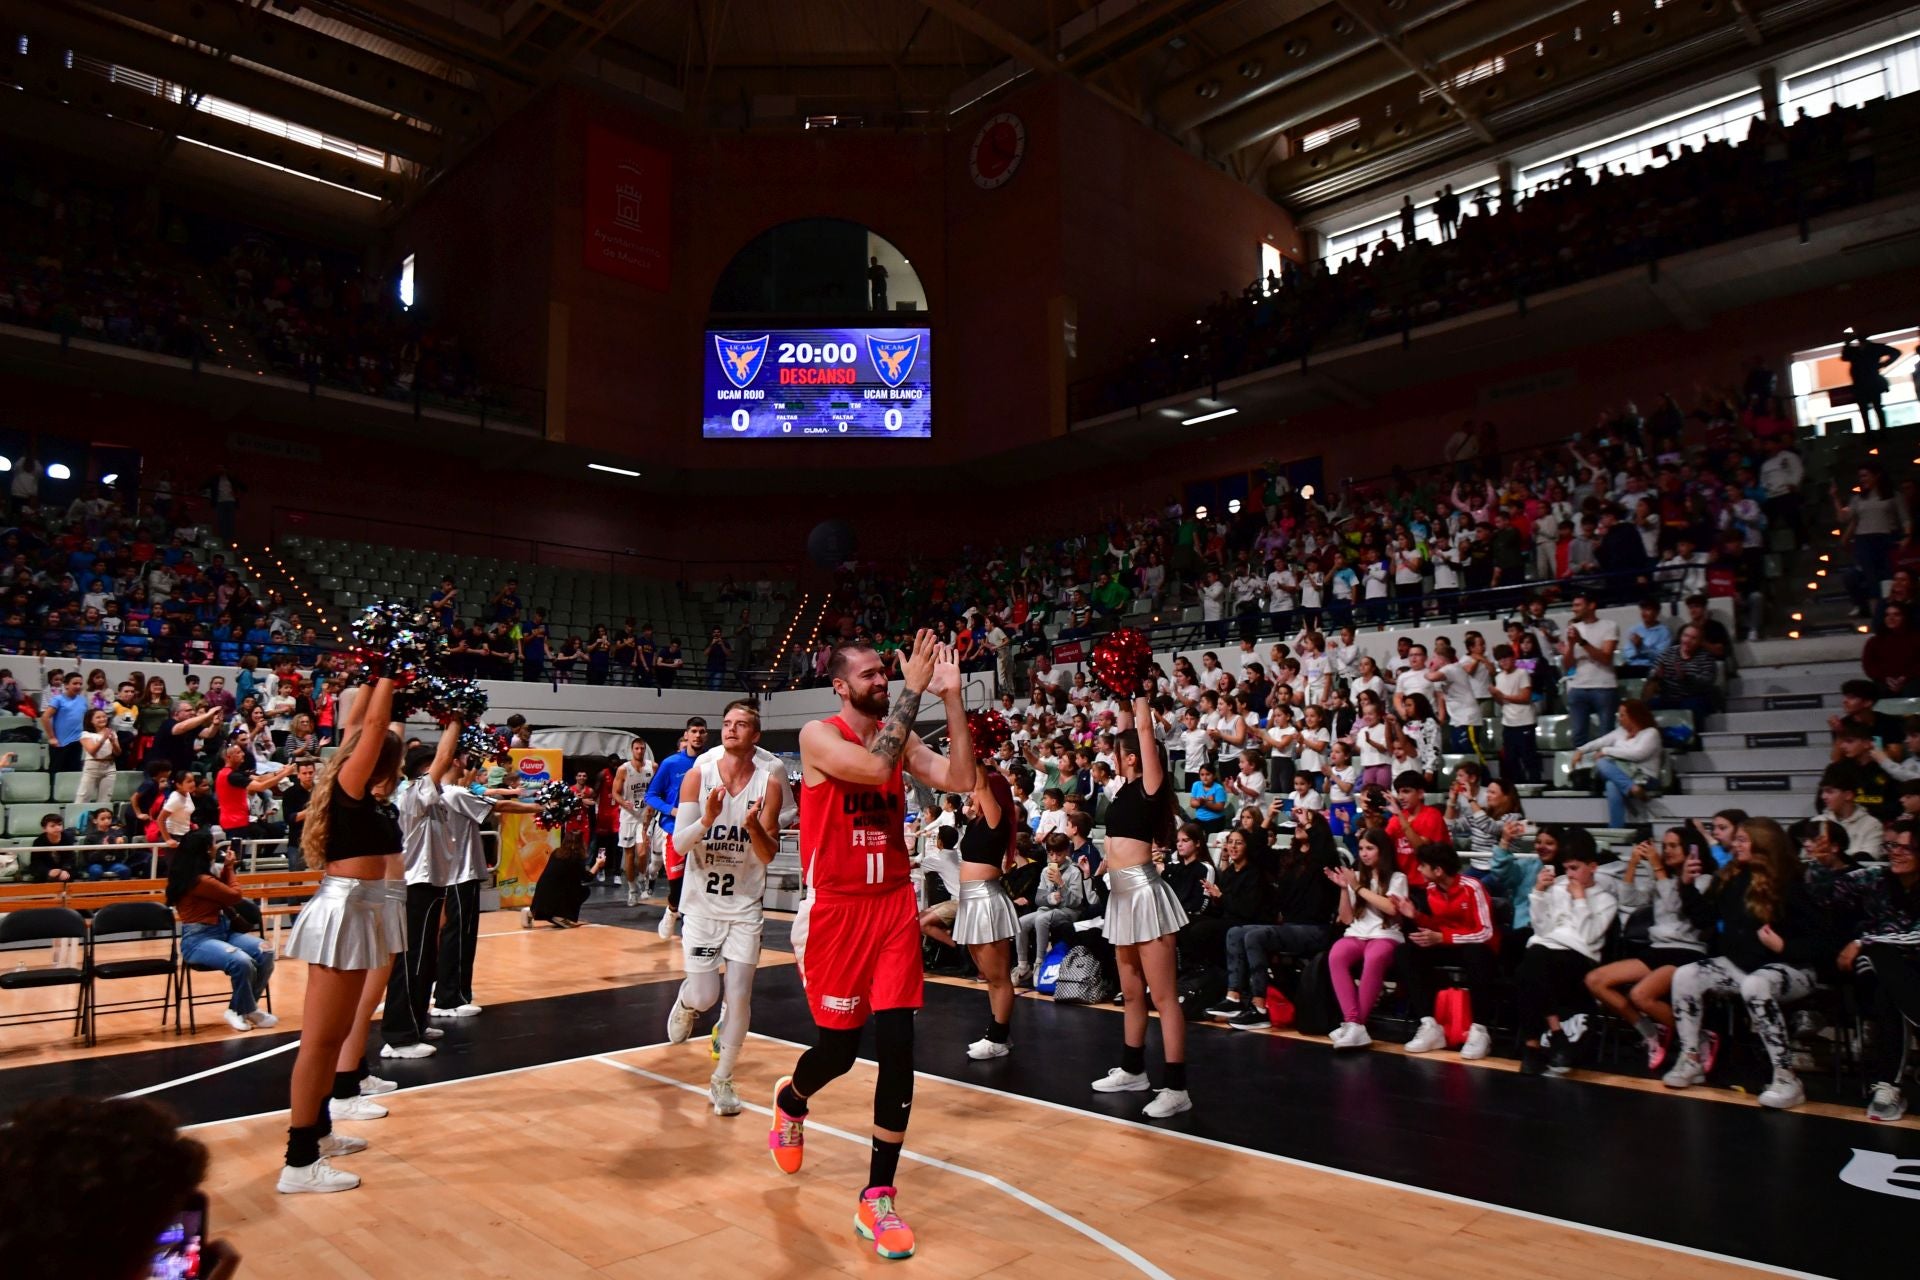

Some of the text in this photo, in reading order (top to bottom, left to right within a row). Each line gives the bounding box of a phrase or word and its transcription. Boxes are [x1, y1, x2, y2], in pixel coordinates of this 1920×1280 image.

[778, 342, 857, 364] 20:00
[780, 367, 856, 385] DESCANSO
[717, 389, 765, 400] UCAM ROJO
[864, 389, 923, 399] UCAM BLANCO
[731, 409, 750, 432] 0
[782, 421, 792, 433] 0
[838, 421, 848, 433] 0
[884, 408, 903, 431] 0
[521, 762, 544, 770] Juver
[706, 842, 745, 853] MURCIA
[866, 852, 885, 885] 11
[706, 872, 735, 896] 22
